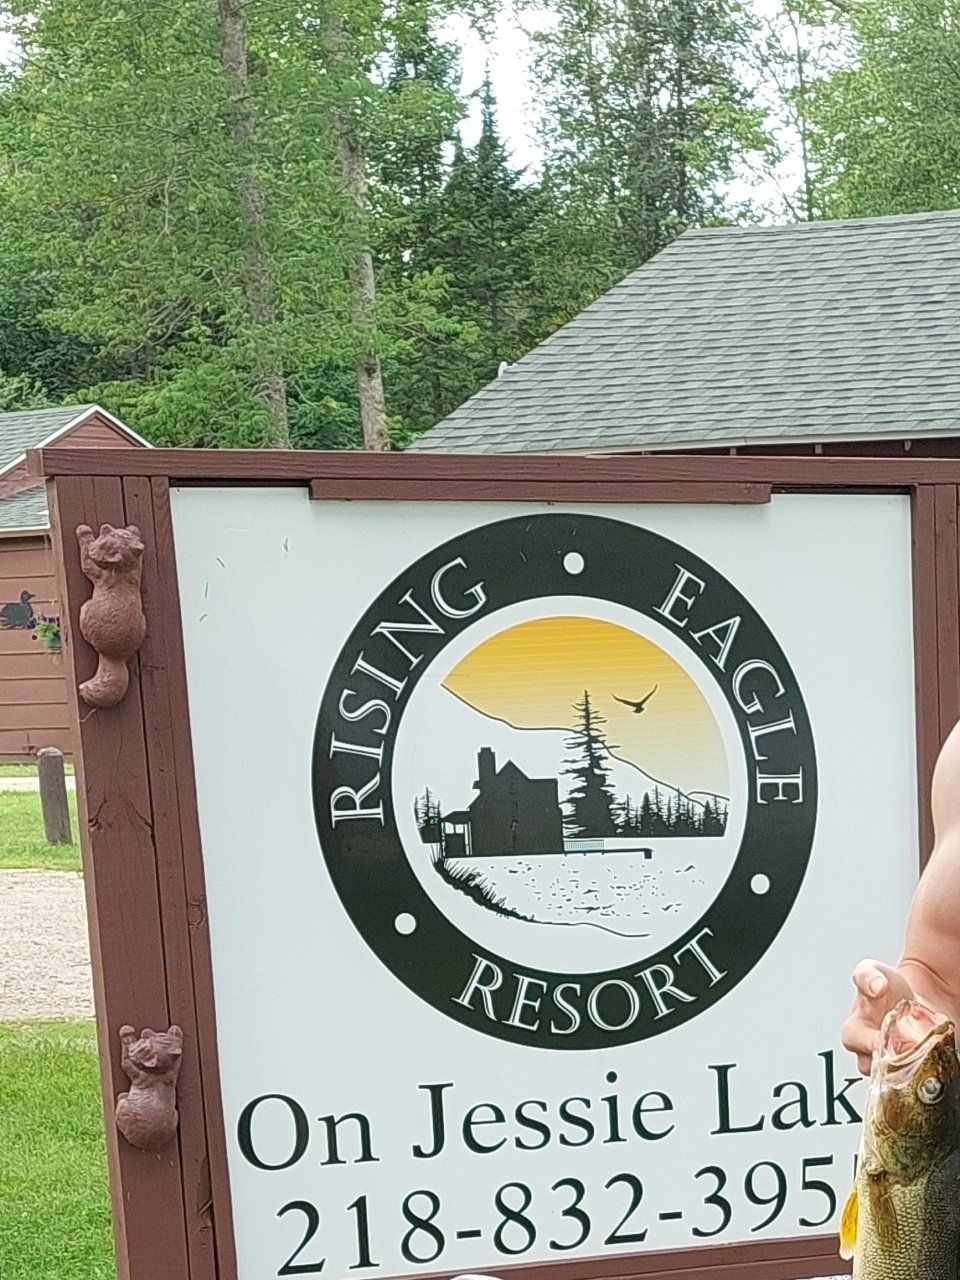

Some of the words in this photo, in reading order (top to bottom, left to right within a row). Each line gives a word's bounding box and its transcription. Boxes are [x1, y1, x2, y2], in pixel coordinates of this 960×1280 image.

[330, 556, 488, 828] RISING
[652, 563, 804, 805] EAGLE
[450, 926, 728, 1035] RESORT
[237, 1093, 381, 1171] On
[412, 1071, 676, 1159] Jessie
[707, 1049, 863, 1135] Lak
[276, 1154, 858, 1276] 218-832-395
